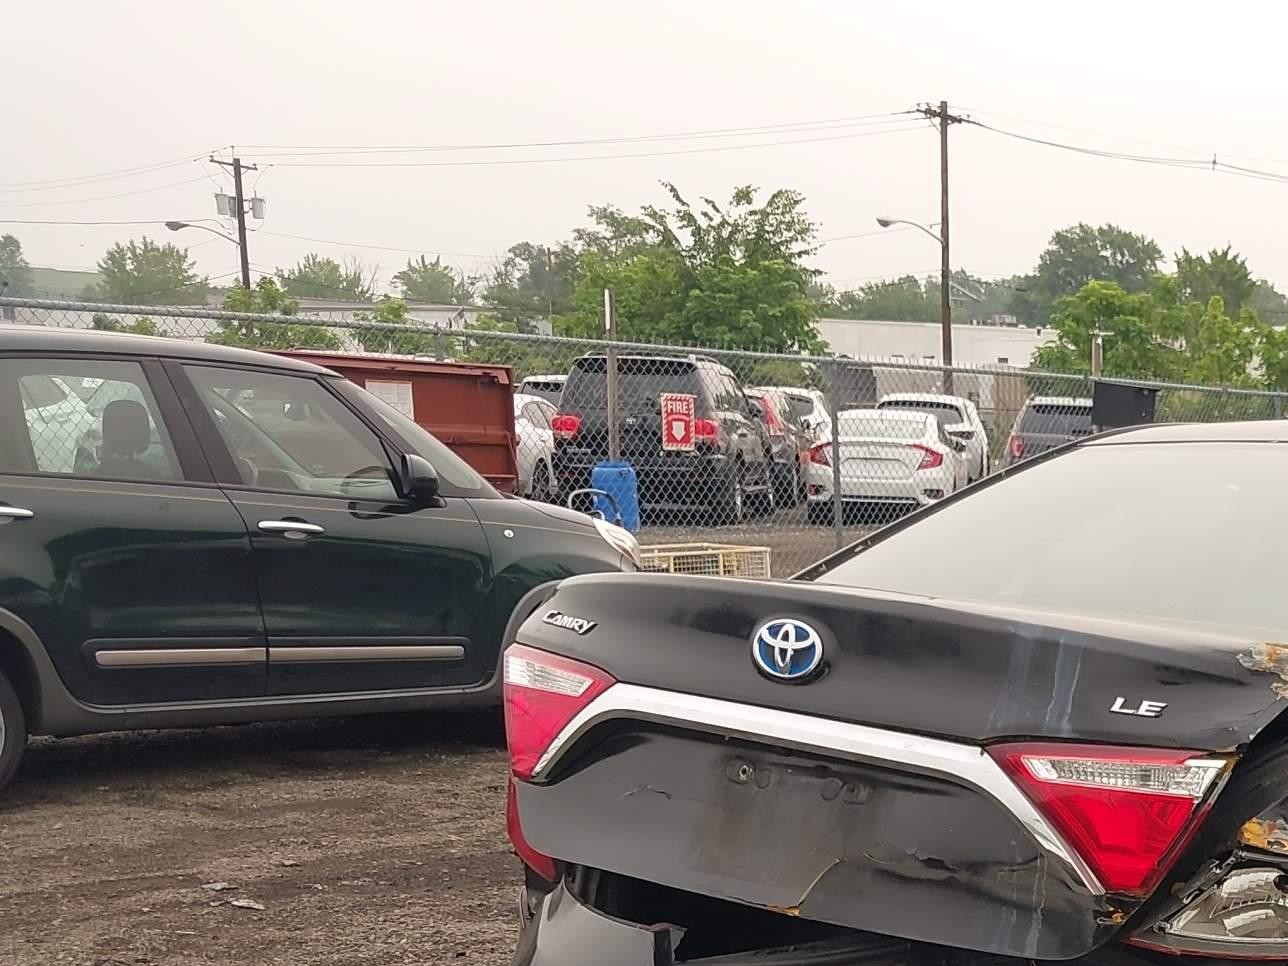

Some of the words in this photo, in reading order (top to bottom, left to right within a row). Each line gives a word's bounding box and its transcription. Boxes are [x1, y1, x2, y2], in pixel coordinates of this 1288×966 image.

[667, 401, 689, 414] FIRE
[542, 609, 597, 634] CAMRY
[1109, 696, 1168, 717] LE
